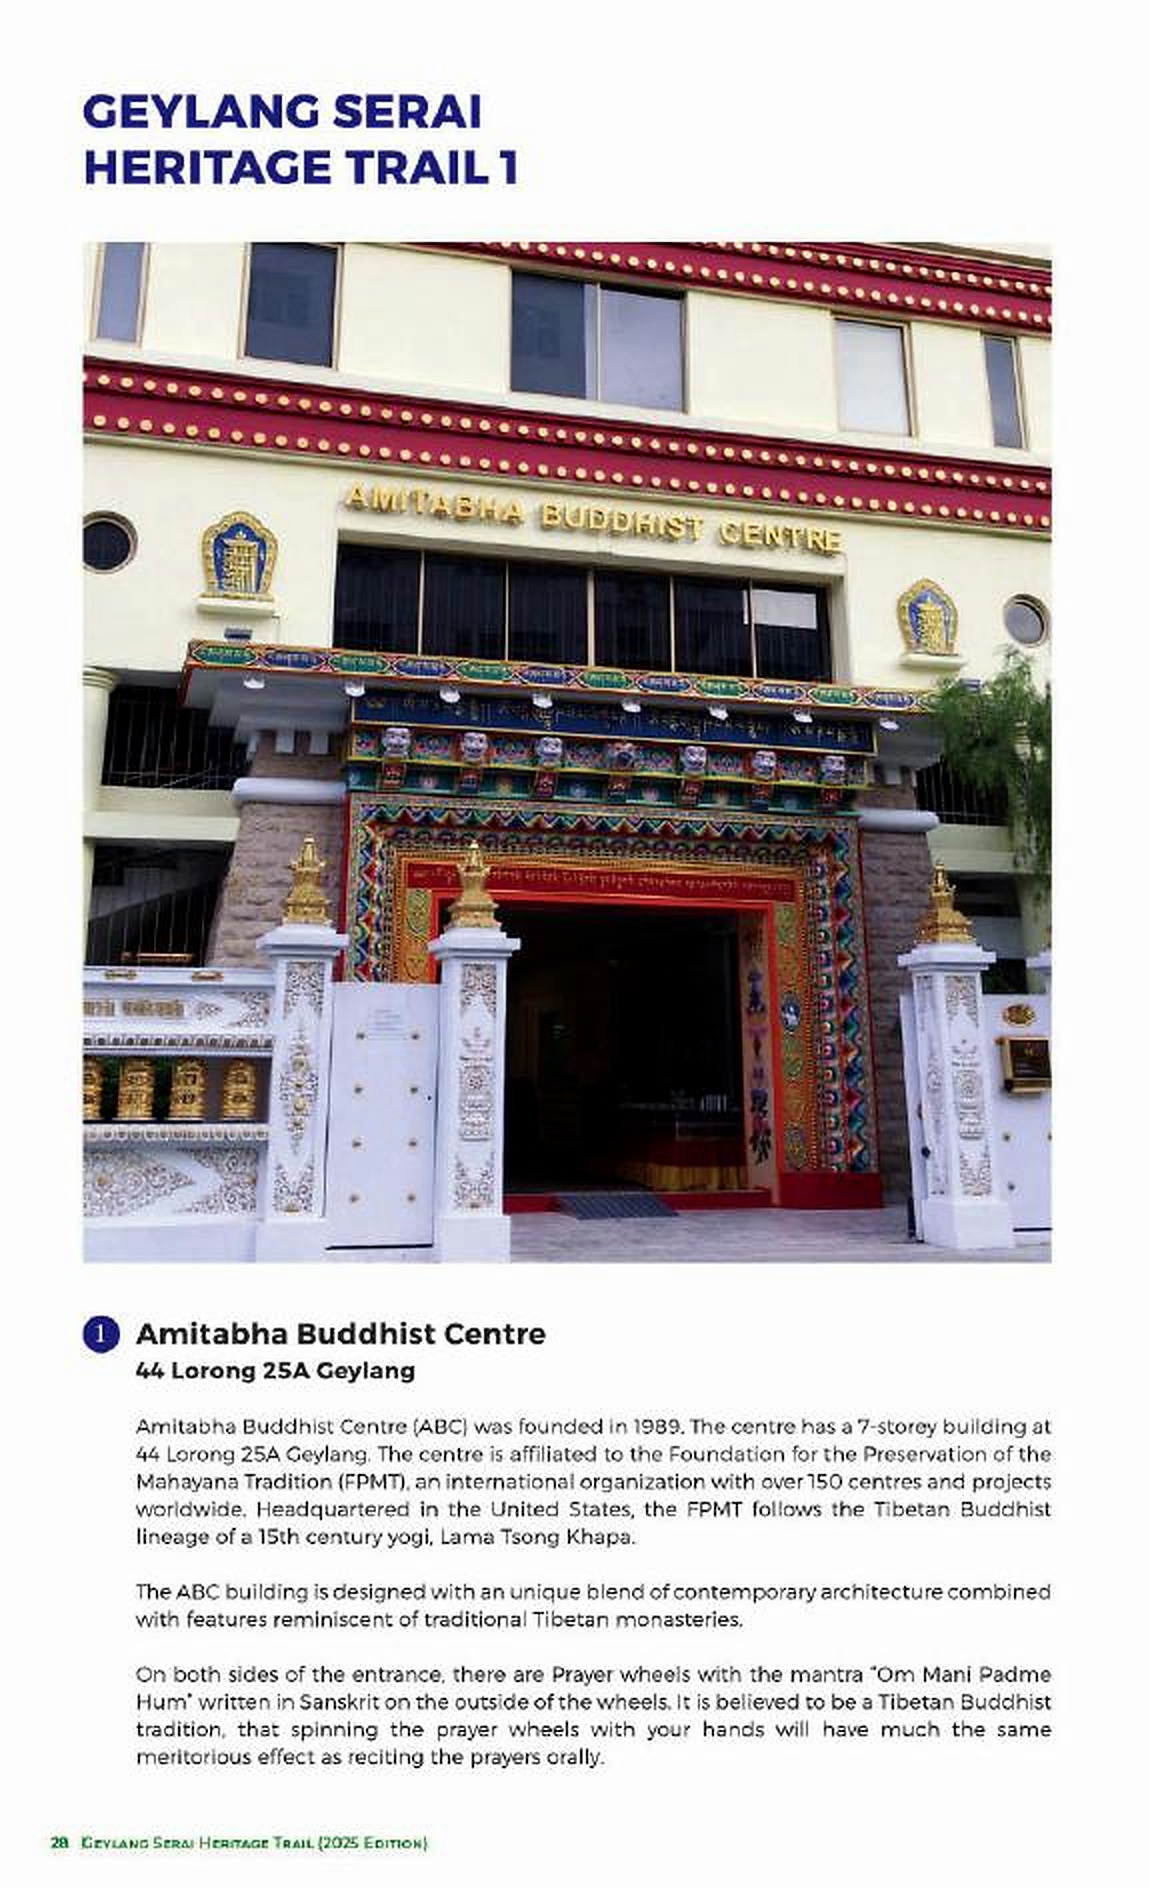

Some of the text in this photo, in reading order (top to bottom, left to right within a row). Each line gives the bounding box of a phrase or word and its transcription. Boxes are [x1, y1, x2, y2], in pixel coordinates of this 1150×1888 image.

[83, 94, 480, 128] GEYLANG SERAI
[86, 150, 516, 184] HERITAGE TRAIL 1
[344, 480, 847, 556] AMITABHA BUDDHIST CENTRE
[94, 1325, 105, 1343] 1
[136, 1321, 546, 1345] Amitabha Buddhist Centre
[136, 1361, 415, 1383] 44 Lorong 25A Geylang
[135, 1416, 1052, 1439] Amitabha Buddhist Centre (ABC) was founded in 1989. The centre has a 7-storey building at
[135, 1444, 1052, 1466] 44 Lorong 25A Geylang. The centre is affiliated to the Foundation for the Preservation of the
[137, 1472, 1052, 1494] Mahayana Tradition (FPMT), an international organization with over 150 centres and projects
[136, 1500, 1052, 1521] worldwide. Headquartered in the United States, the FPMT follows the Tibetan Buddhist
[137, 1527, 637, 1549] lineage of a 15th century yogi, Lama Tsong Khapa.
[136, 1583, 1052, 1604] The ABC building is designed with an unique blend of contemporary architecture combined
[135, 1609, 743, 1629] with features reminiscent of traditional Tibetan monasteries.
[136, 1666, 166, 1683] On
[170, 1666, 221, 1683] both
[228, 1666, 279, 1683] sides
[285, 1665, 306, 1683] of
[312, 1665, 345, 1683] the
[352, 1667, 445, 1684] entrance,
[453, 1665, 506, 1683] there
[513, 1669, 544, 1683] are
[552, 1666, 615, 1687] Prayer
[619, 1665, 691, 1683] wheels
[697, 1666, 742, 1683] with
[749, 1665, 783, 1683] the
[790, 1667, 863, 1683] mantra
[923, 1665, 971, 1683] Mani
[979, 1665, 1052, 1683] Padme
[198, 1693, 270, 1711] written
[277, 1693, 295, 1711] in
[300, 1693, 380, 1711] Sanskrit
[384, 1697, 411, 1711] on
[415, 1693, 449, 1711] the
[455, 1693, 529, 1711] outside
[533, 1693, 554, 1711] of
[558, 1693, 592, 1711] the
[596, 1693, 672, 1711] wheels.
[677, 1694, 691, 1710] It
[697, 1693, 710, 1711] is
[716, 1693, 799, 1711] believed
[805, 1696, 825, 1711] to
[831, 1693, 857, 1711] be
[862, 1697, 873, 1710] a
[878, 1693, 954, 1711] Tibetan
[961, 1693, 1052, 1711] Buddhist
[136, 1719, 1052, 1742] tradition, that spinning the prayer wheels with your hands will have much the same
[137, 1747, 605, 1769] meritorious effect as reciting the prayers orally.
[50, 1836, 69, 1849] 28
[318, 1836, 359, 1853] (2025
